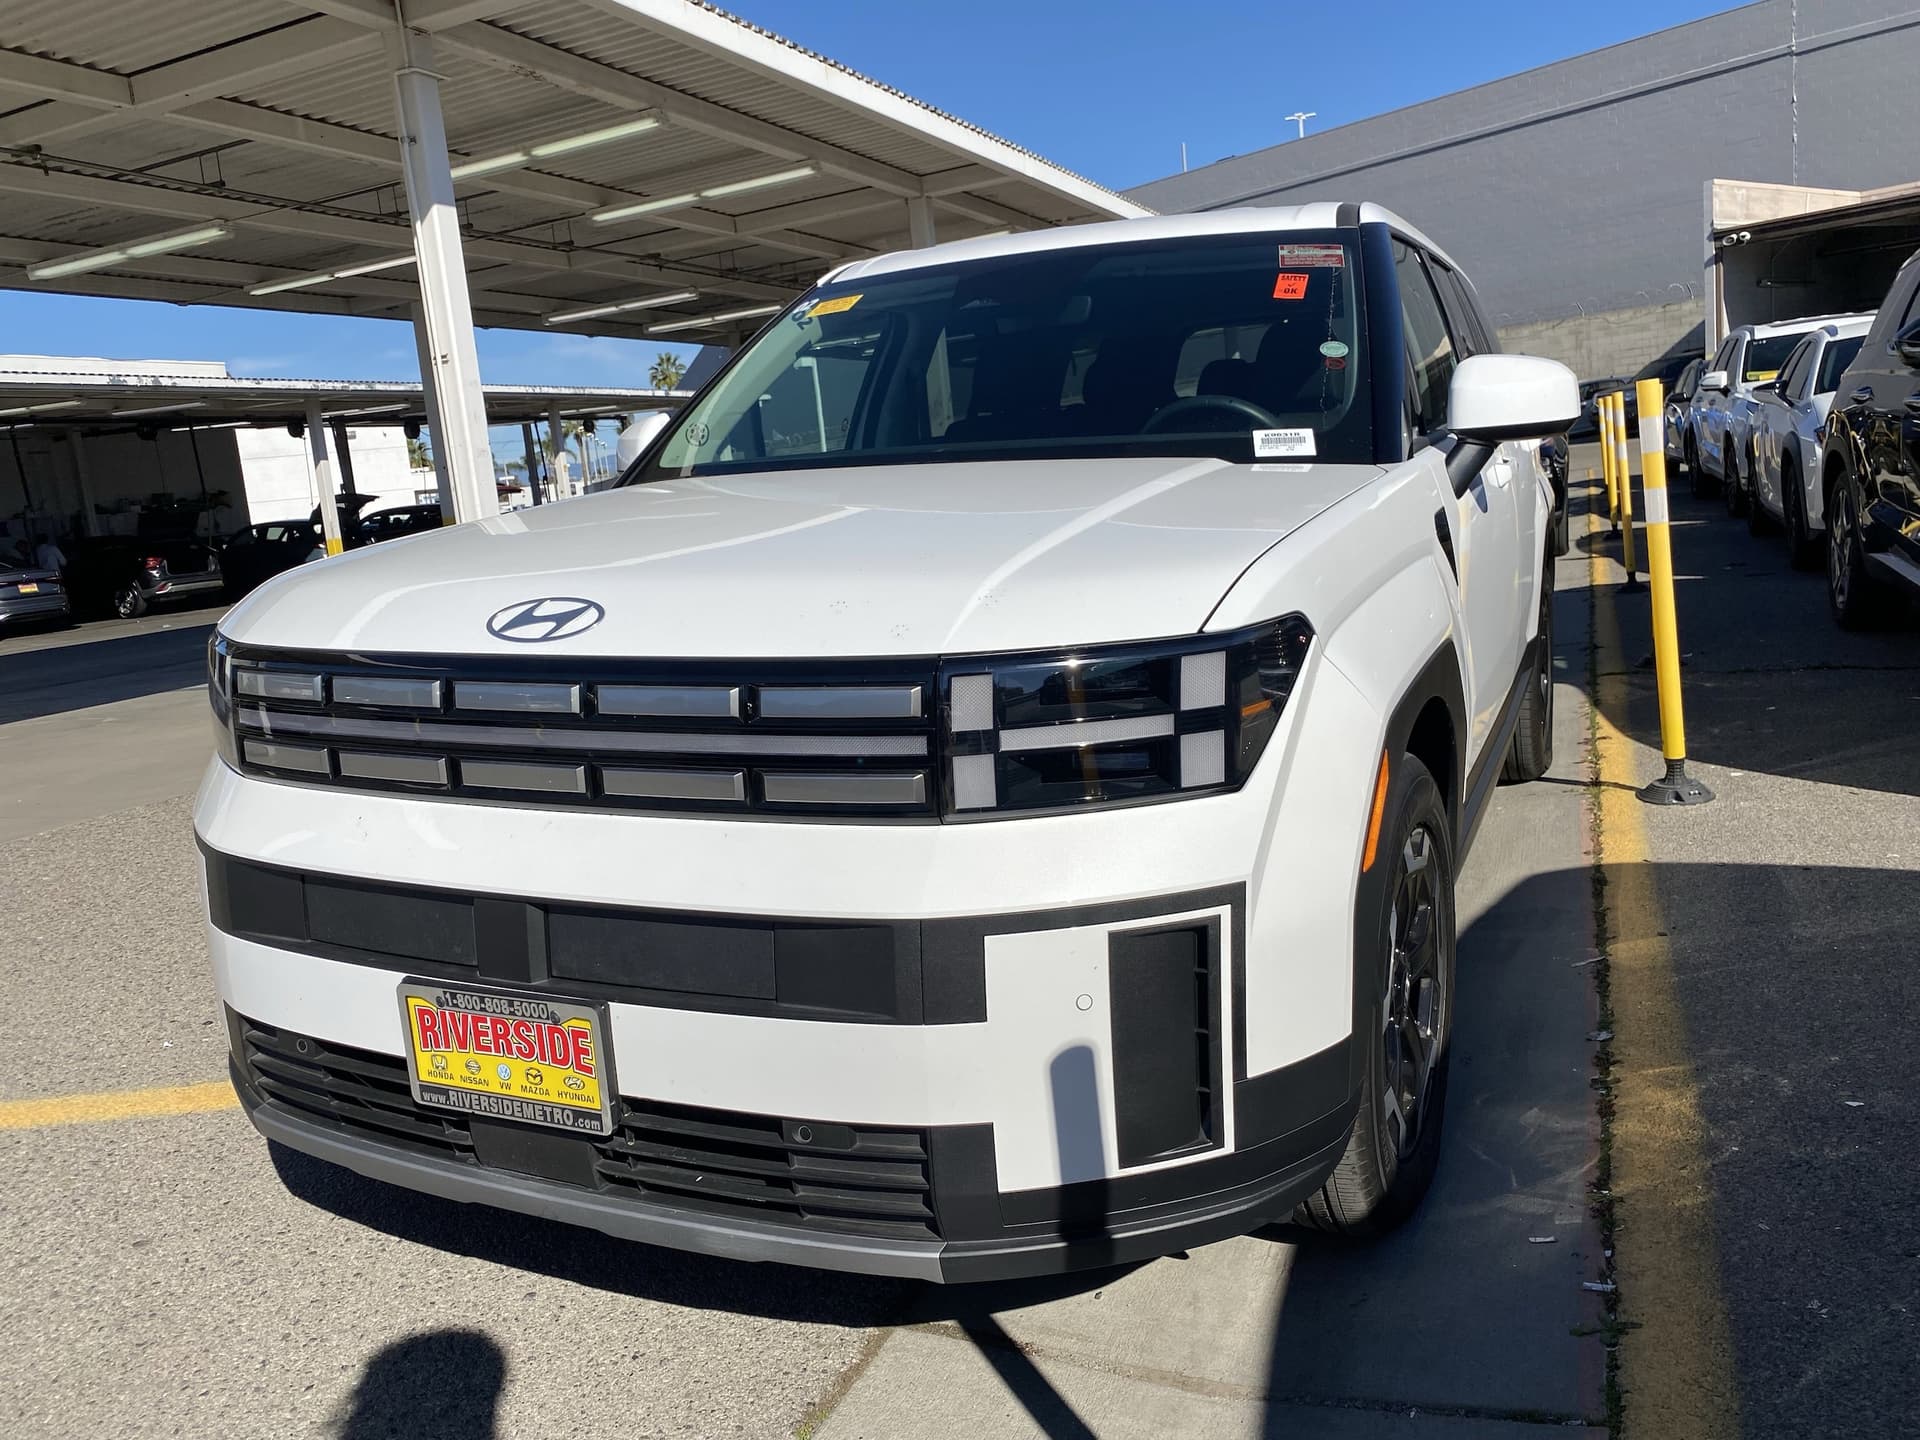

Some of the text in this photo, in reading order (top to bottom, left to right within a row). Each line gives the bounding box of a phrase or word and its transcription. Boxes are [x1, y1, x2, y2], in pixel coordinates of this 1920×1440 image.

[1283, 287, 1298, 295] OK
[445, 994, 548, 1019] 1-800-808-5000
[416, 1005, 597, 1079] RIVERSIDE
[427, 1069, 455, 1081] HONDA
[460, 1074, 489, 1087] NISSAN
[499, 1081, 512, 1091] VW
[520, 1085, 550, 1097] MAZDA
[557, 1091, 595, 1104] HYUNDAI
[422, 1090, 602, 1131] www.RIVERSIDEMETRO.com
